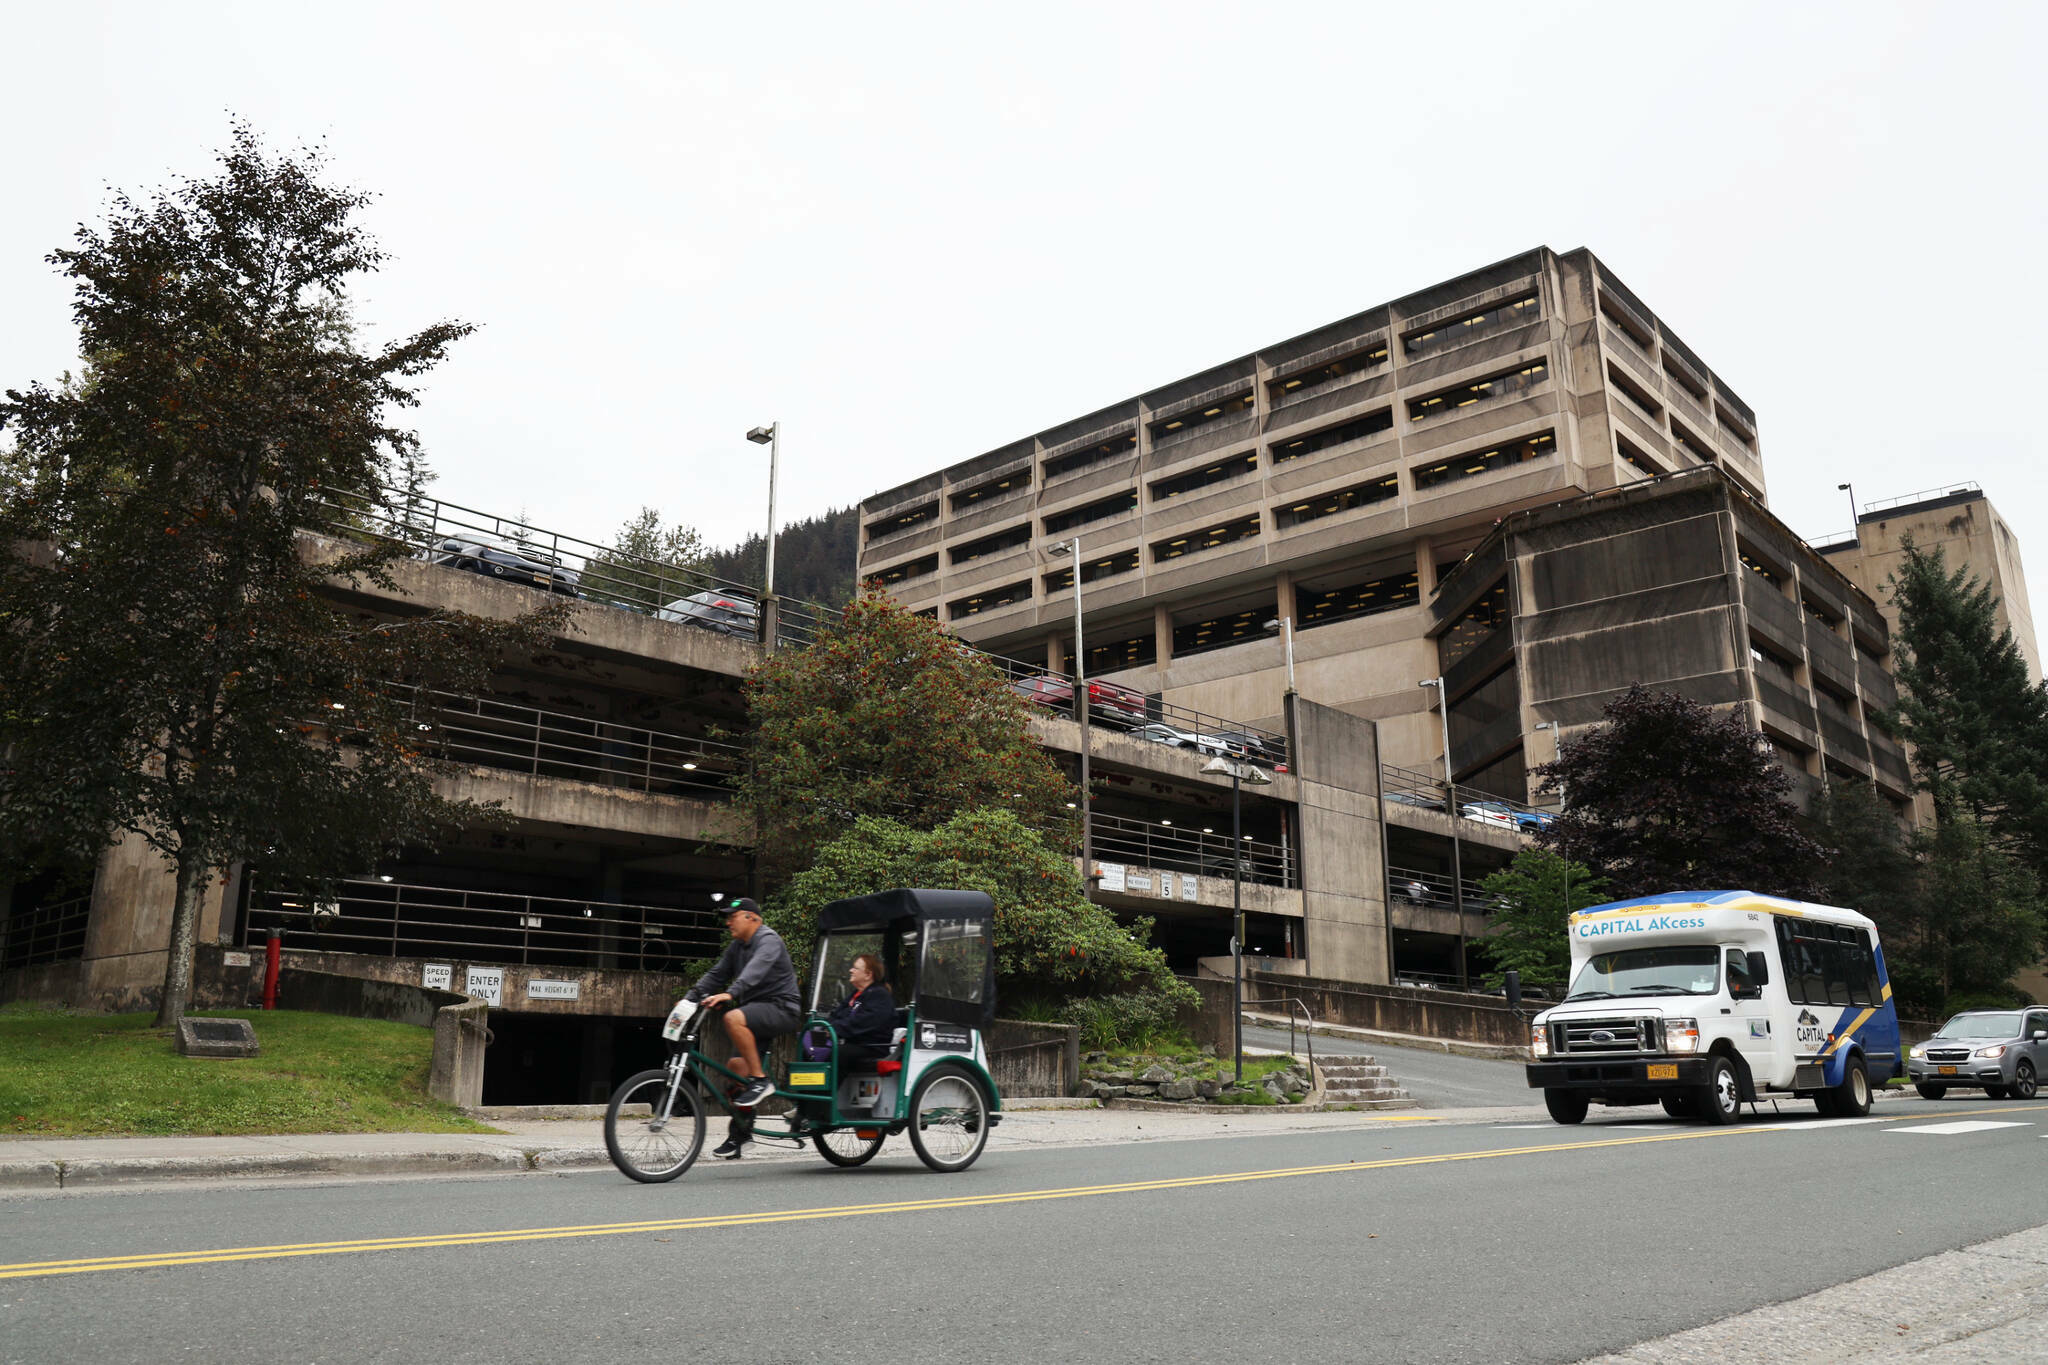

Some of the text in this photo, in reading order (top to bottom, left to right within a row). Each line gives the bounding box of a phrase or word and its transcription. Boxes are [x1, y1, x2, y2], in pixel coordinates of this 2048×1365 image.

[1183, 880, 1196, 888] ENTER
[1164, 886, 1170, 896] 5
[1184, 888, 1195, 896] ONLY
[1579, 916, 1705, 937] CAPITAL AKcess
[426, 967, 450, 976] SPEED
[427, 977, 447, 985] LIMIT
[470, 975, 500, 987] ENTER
[470, 988, 497, 999] ONLY
[530, 985, 541, 993] MAX
[544, 985, 562, 994] HEIGHT
[1796, 1027, 1826, 1042] CAPITAL
